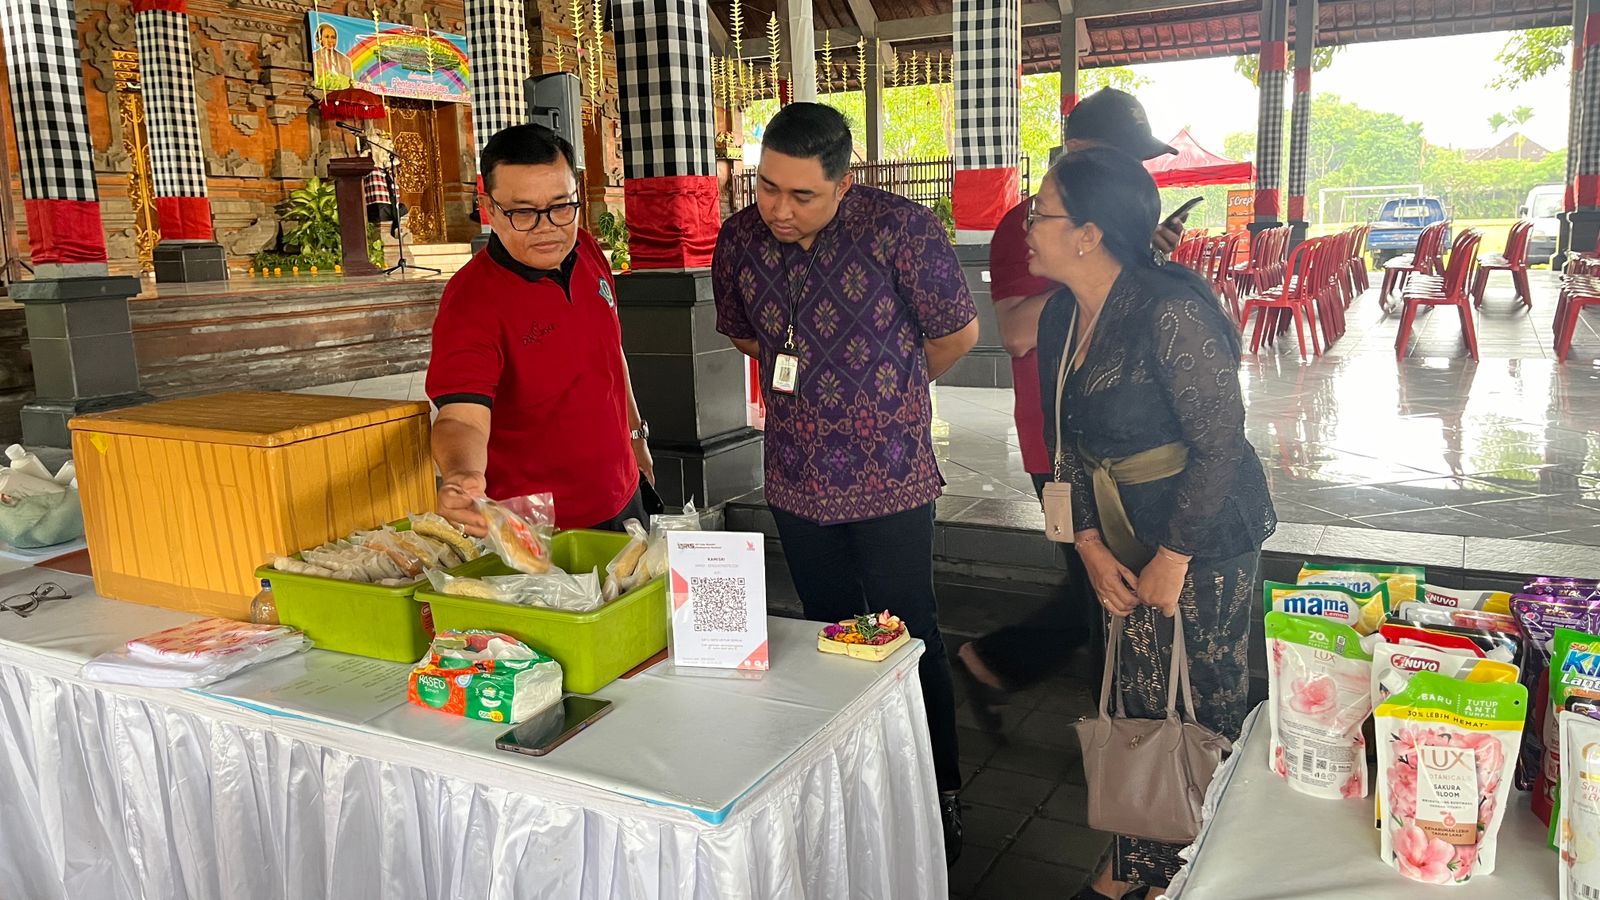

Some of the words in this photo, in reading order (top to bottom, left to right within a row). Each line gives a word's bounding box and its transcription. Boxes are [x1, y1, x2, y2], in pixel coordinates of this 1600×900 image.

[1430, 592, 1457, 607] NUVO
[1283, 597, 1349, 616] mama
[1314, 650, 1336, 664] LUX
[1404, 659, 1438, 672] NUVO
[1421, 693, 1452, 705] BARU
[1467, 699, 1498, 708] TUTUP
[1426, 711, 1450, 720] LEBIH
[1465, 706, 1496, 714] ANTI
[1421, 749, 1473, 771] LUX
